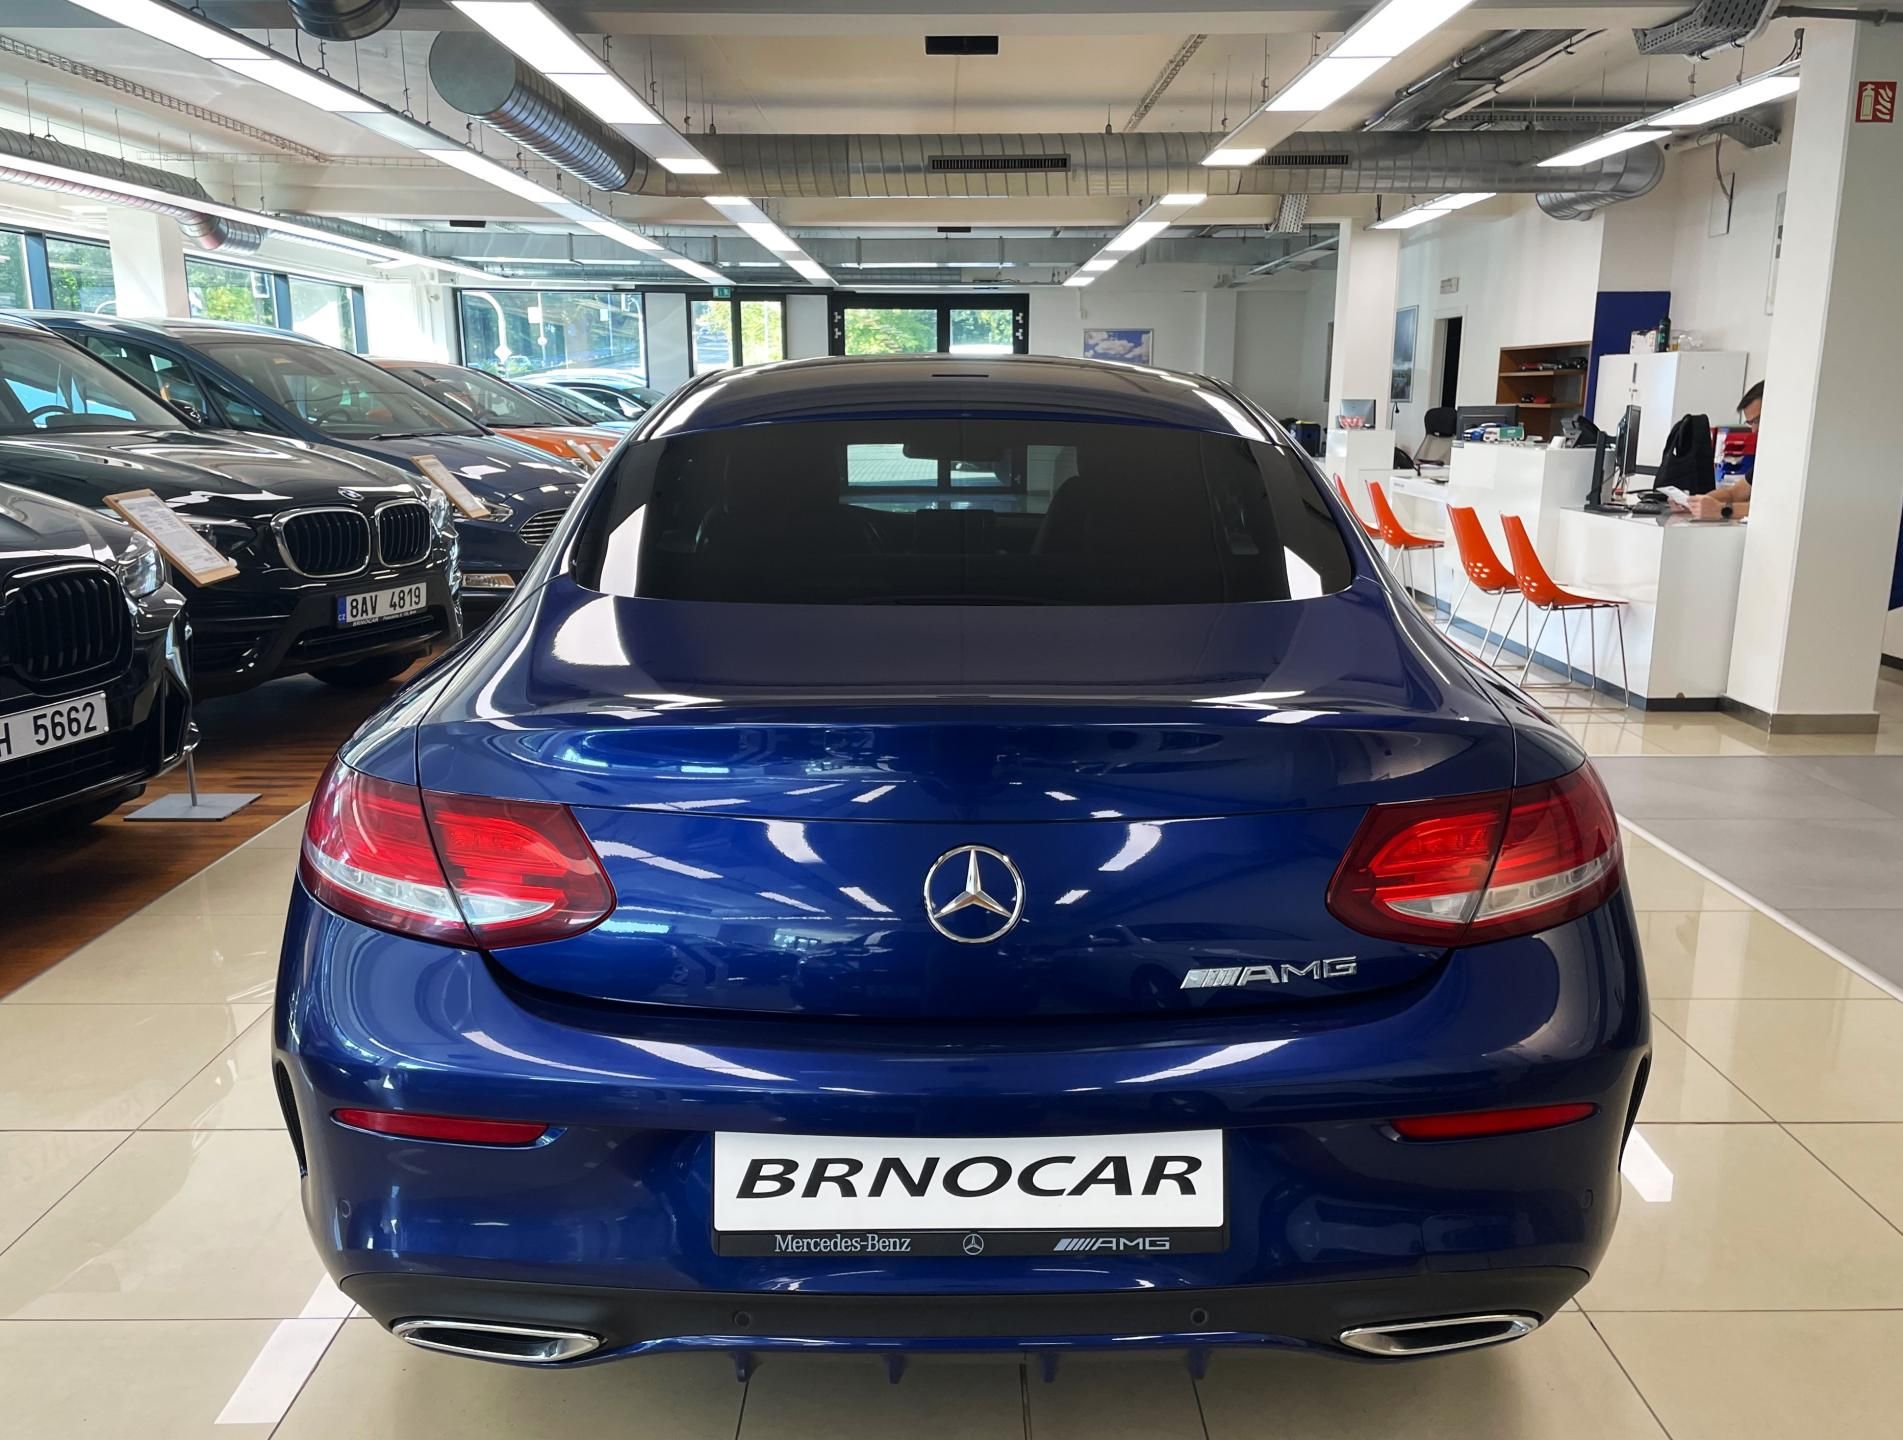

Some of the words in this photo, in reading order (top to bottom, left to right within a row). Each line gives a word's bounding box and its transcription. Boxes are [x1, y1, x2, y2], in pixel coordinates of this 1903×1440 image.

[337, 613, 346, 622] CZ
[350, 594, 378, 619] 8AV
[389, 586, 421, 611] 4819
[33, 701, 97, 746] 5662
[1237, 955, 1357, 987] AMG
[736, 1155, 1203, 1199] BRNOCAR
[774, 1233, 912, 1254] Mercedes-Benz
[1093, 1236, 1171, 1251] AMG
